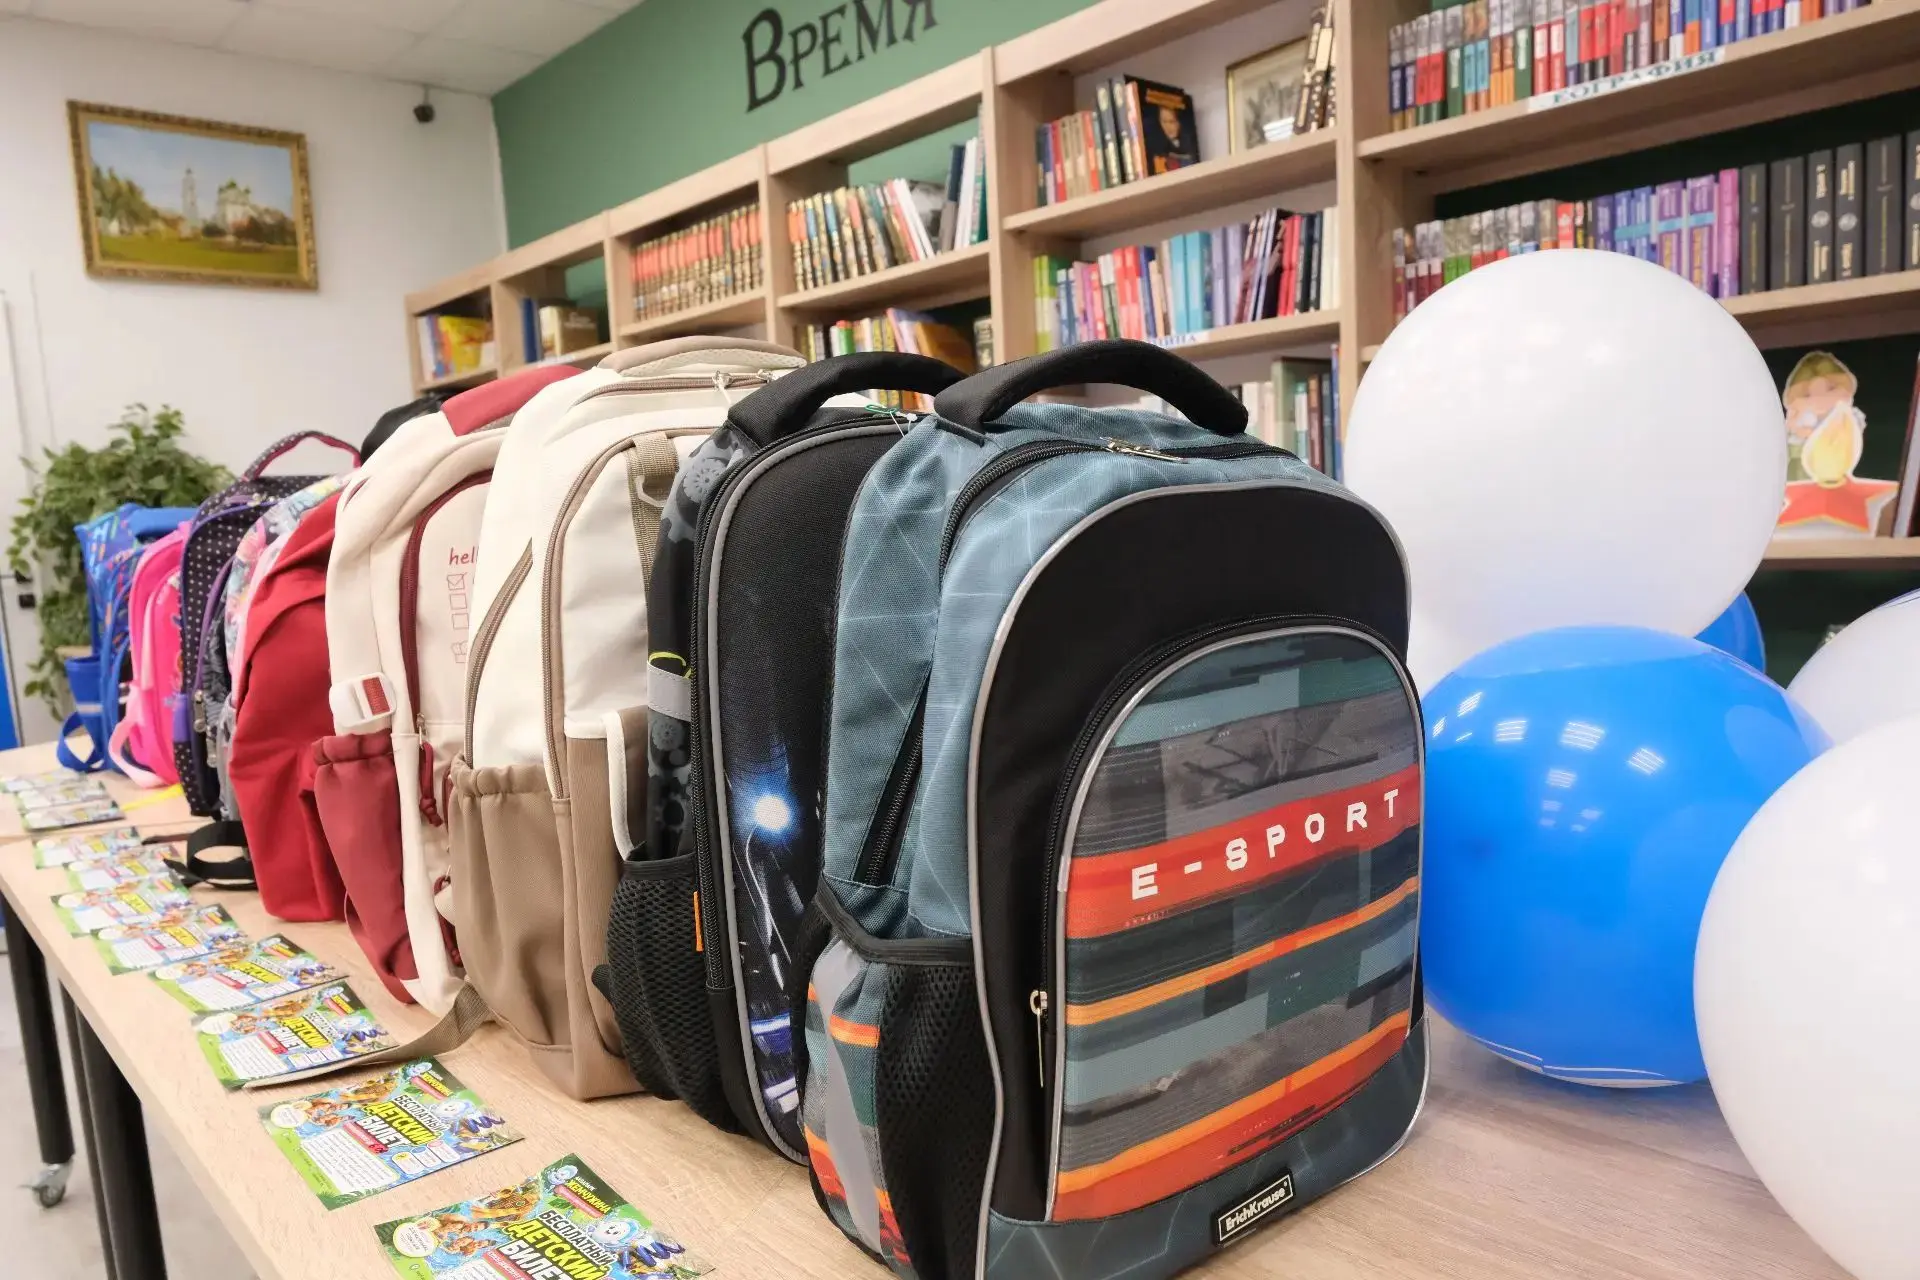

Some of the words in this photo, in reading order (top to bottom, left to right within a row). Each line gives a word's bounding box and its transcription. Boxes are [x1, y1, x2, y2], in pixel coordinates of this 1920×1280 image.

[1225, 1187, 1286, 1232] ErichKrause
[499, 1239, 574, 1280] БИЛЕ
[539, 1209, 619, 1267] БЕСПЛАТНЫЙ
